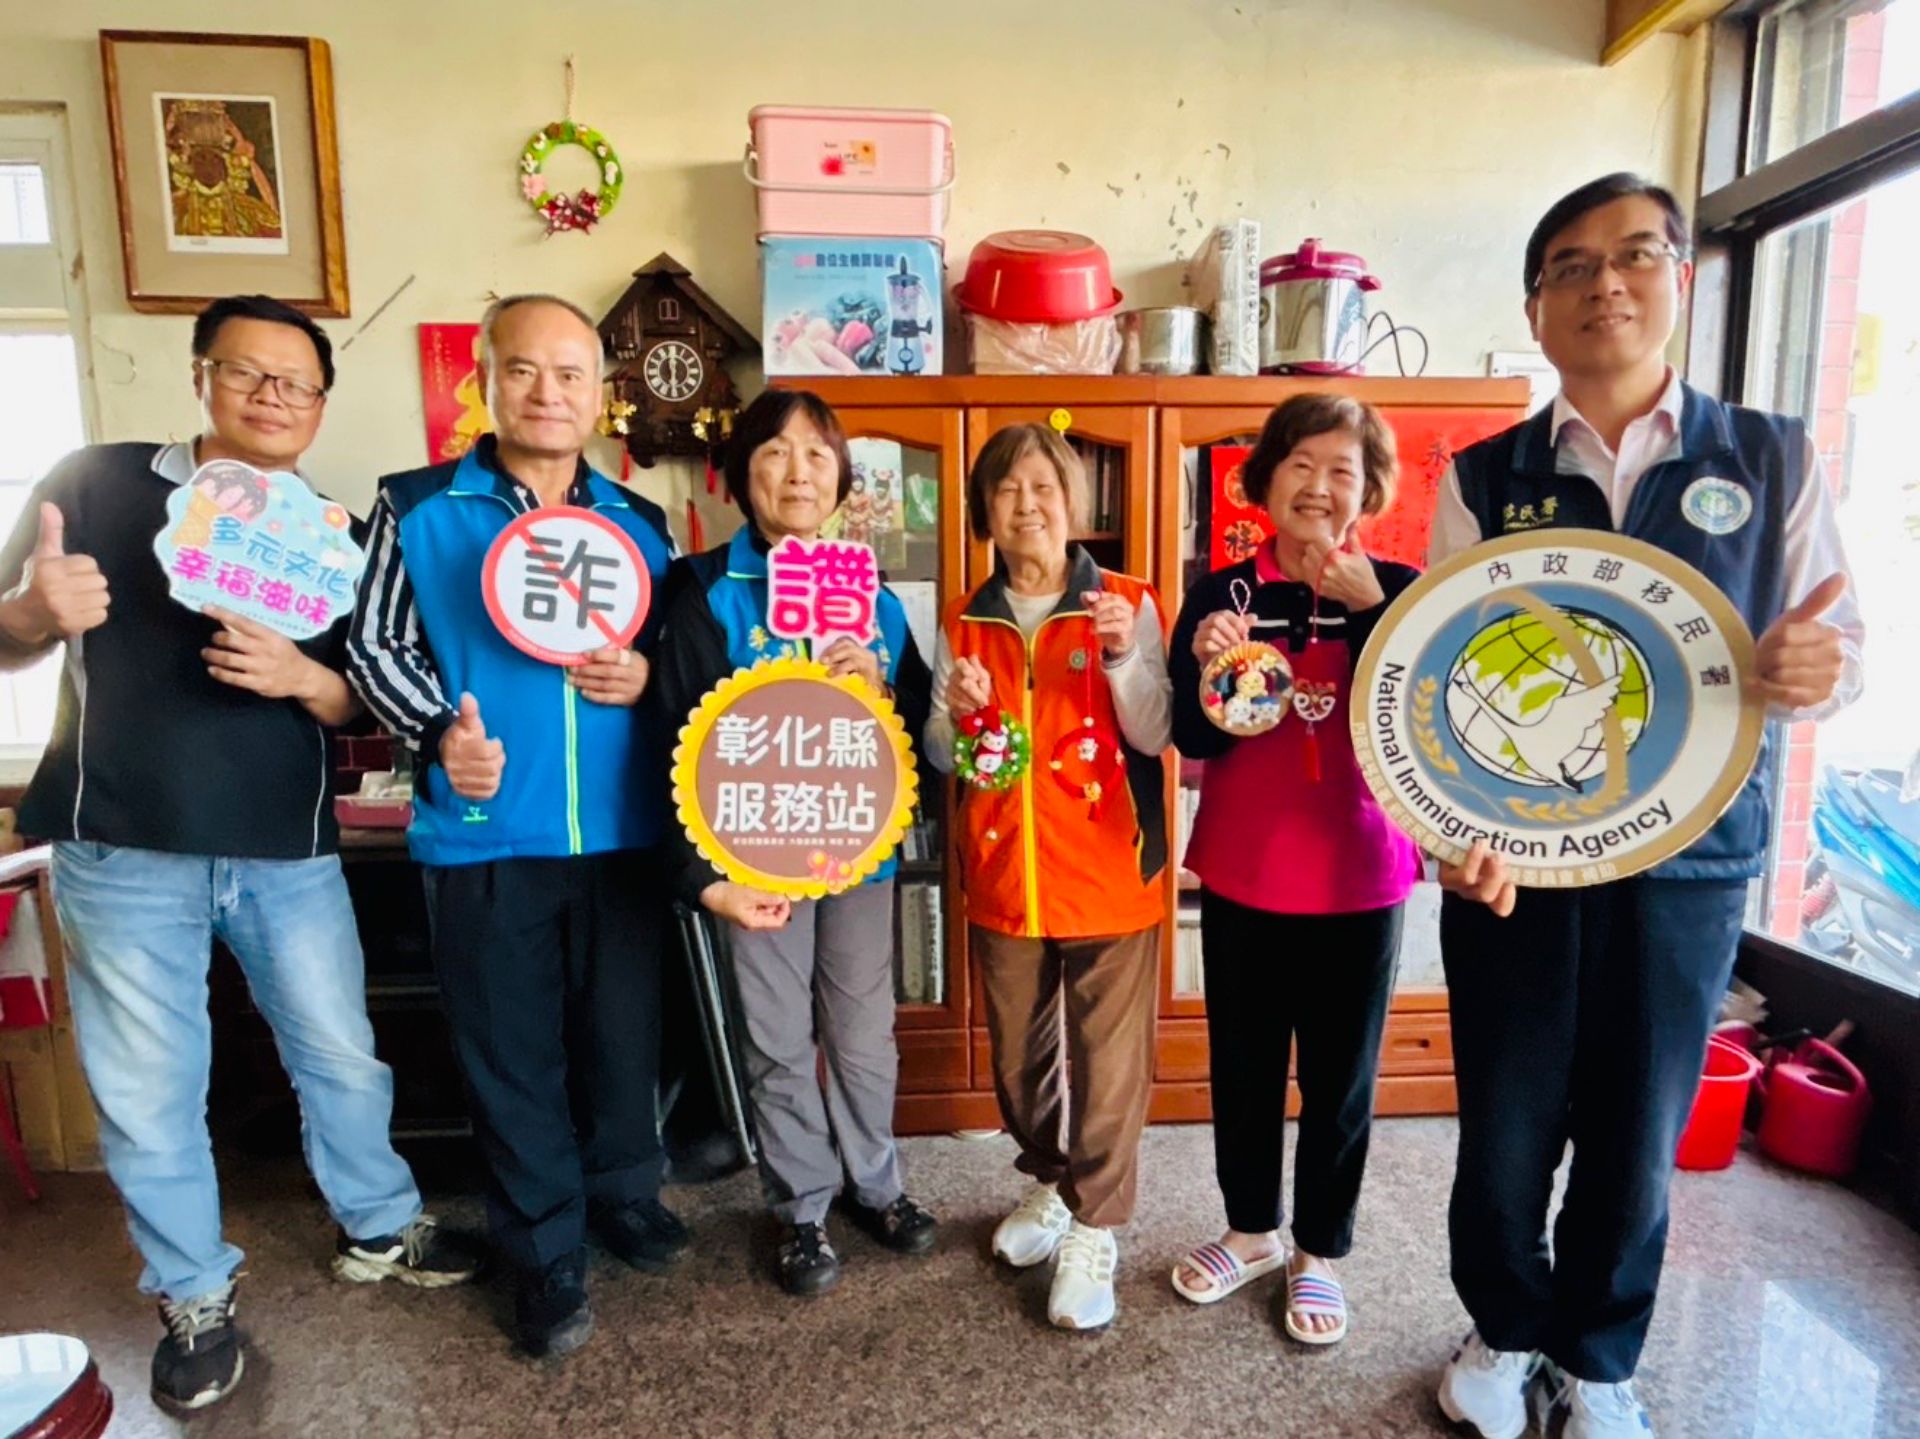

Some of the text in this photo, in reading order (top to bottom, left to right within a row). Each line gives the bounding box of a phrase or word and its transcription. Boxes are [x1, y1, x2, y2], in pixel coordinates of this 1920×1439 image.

[171, 546, 331, 627] 幸福滋味
[213, 515, 350, 597] 多元文化
[523, 536, 620, 630] 詐
[773, 539, 875, 641] 讚
[715, 713, 878, 769] 彰化縣
[1376, 661, 1674, 858] National Immigration Agency
[712, 781, 877, 834] 服務站
